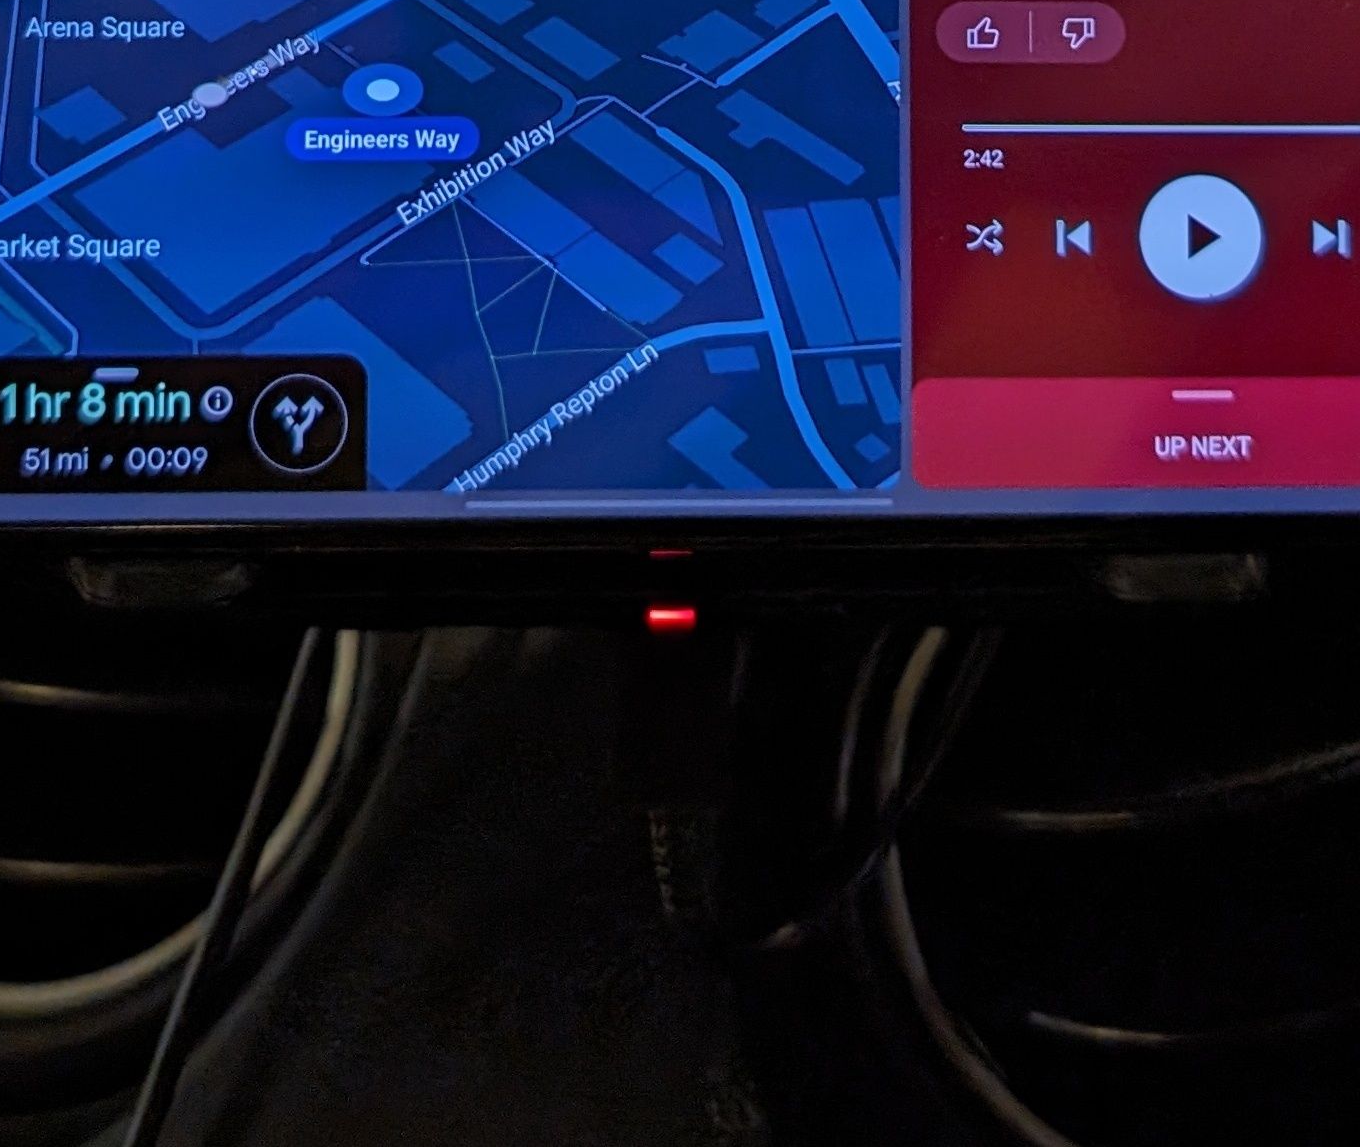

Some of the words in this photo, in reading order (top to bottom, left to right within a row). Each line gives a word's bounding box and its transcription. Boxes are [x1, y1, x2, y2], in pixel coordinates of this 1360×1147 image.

[25, 16, 95, 39] Arena
[100, 15, 186, 43] Square
[267, 29, 320, 66] Way
[304, 129, 409, 154] Engineers
[414, 128, 461, 154] Way
[397, 151, 507, 225] Exhibition
[504, 120, 556, 159] Way
[963, 149, 1005, 170] 2:42
[67, 233, 161, 264] Square
[0, 382, 17, 424] 1
[24, 382, 72, 424] hr
[78, 381, 107, 426] 8
[114, 381, 191, 423] min
[452, 417, 552, 493] Humphry
[550, 364, 629, 427] Repton
[626, 343, 660, 374] Ln
[21, 446, 50, 477] 51
[53, 446, 90, 475] mi
[125, 446, 209, 476] 00:09
[1154, 434, 1187, 459] UP
[1190, 434, 1252, 459] NEXT
